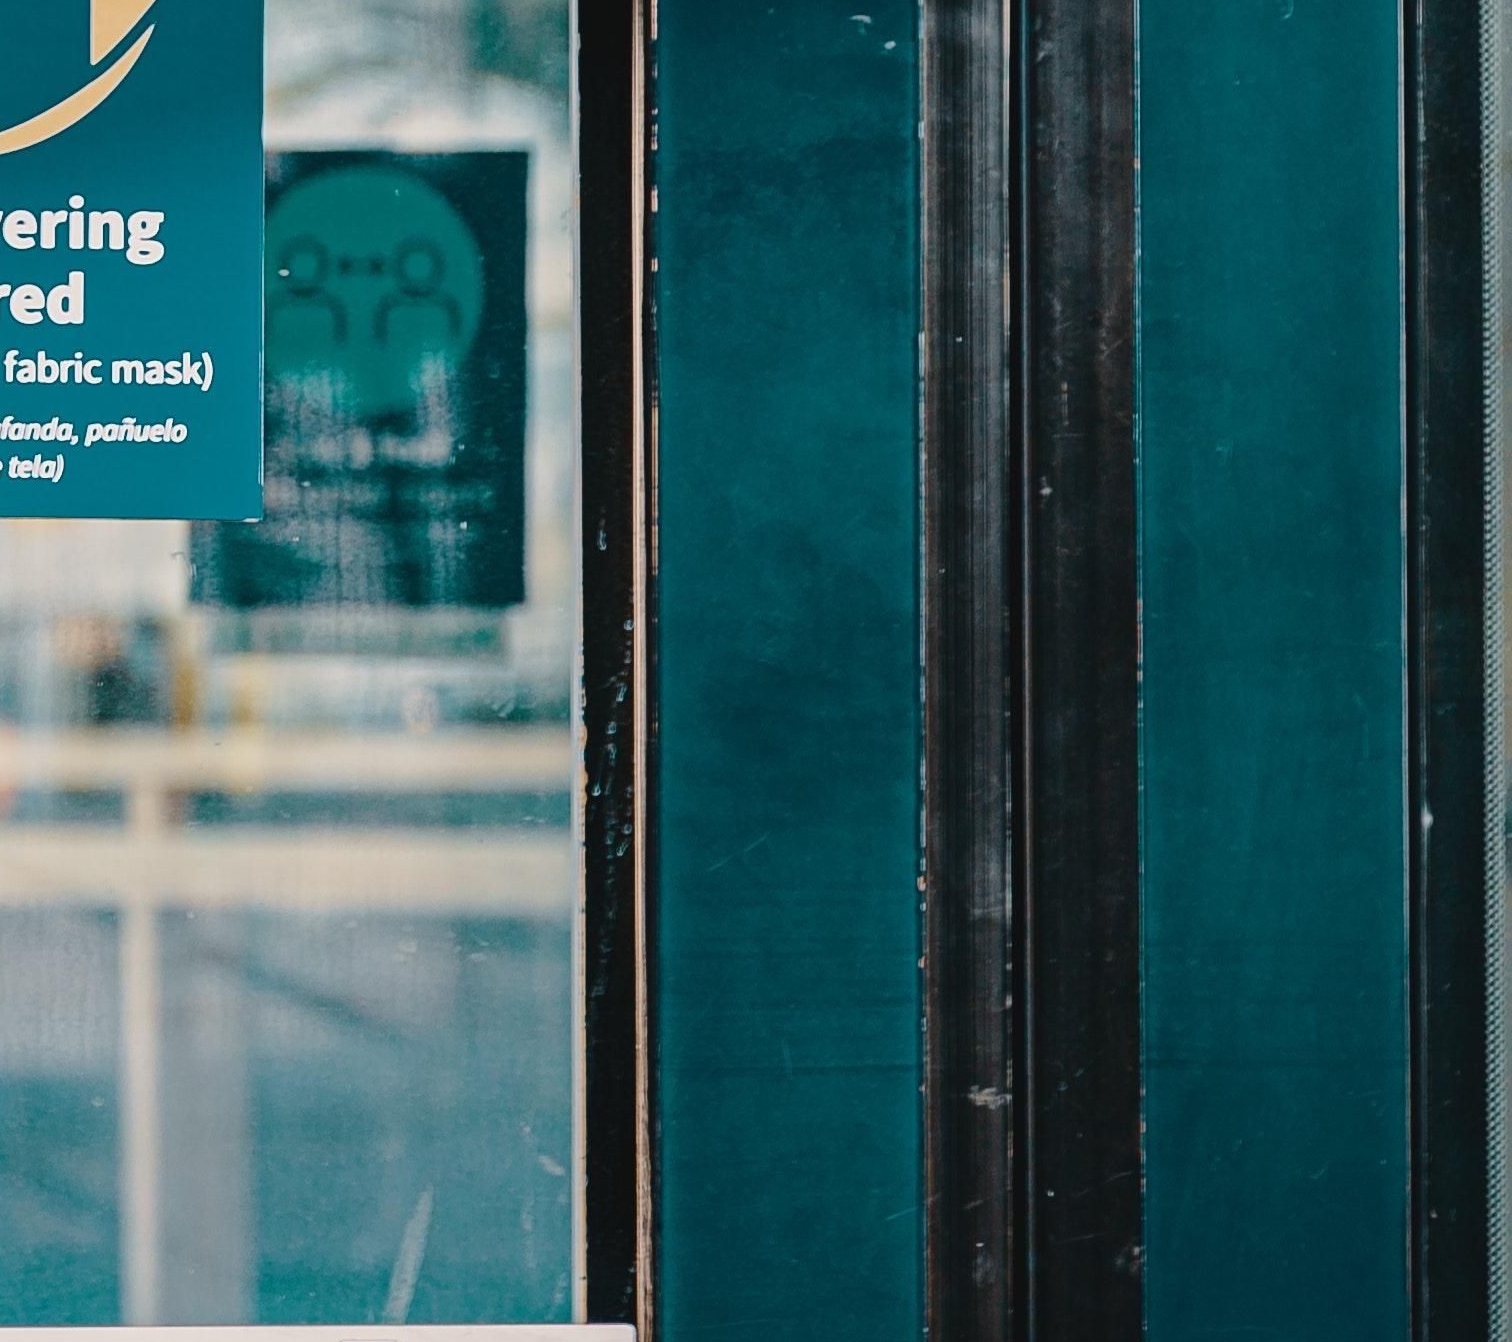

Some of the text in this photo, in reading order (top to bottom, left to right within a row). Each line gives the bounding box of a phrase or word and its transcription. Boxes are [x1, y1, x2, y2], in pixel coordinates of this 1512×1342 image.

[4, 350, 102, 384] fabric
[112, 352, 213, 391] mask)
[84, 418, 187, 446] pañuelo
[9, 454, 64, 482] tela)
